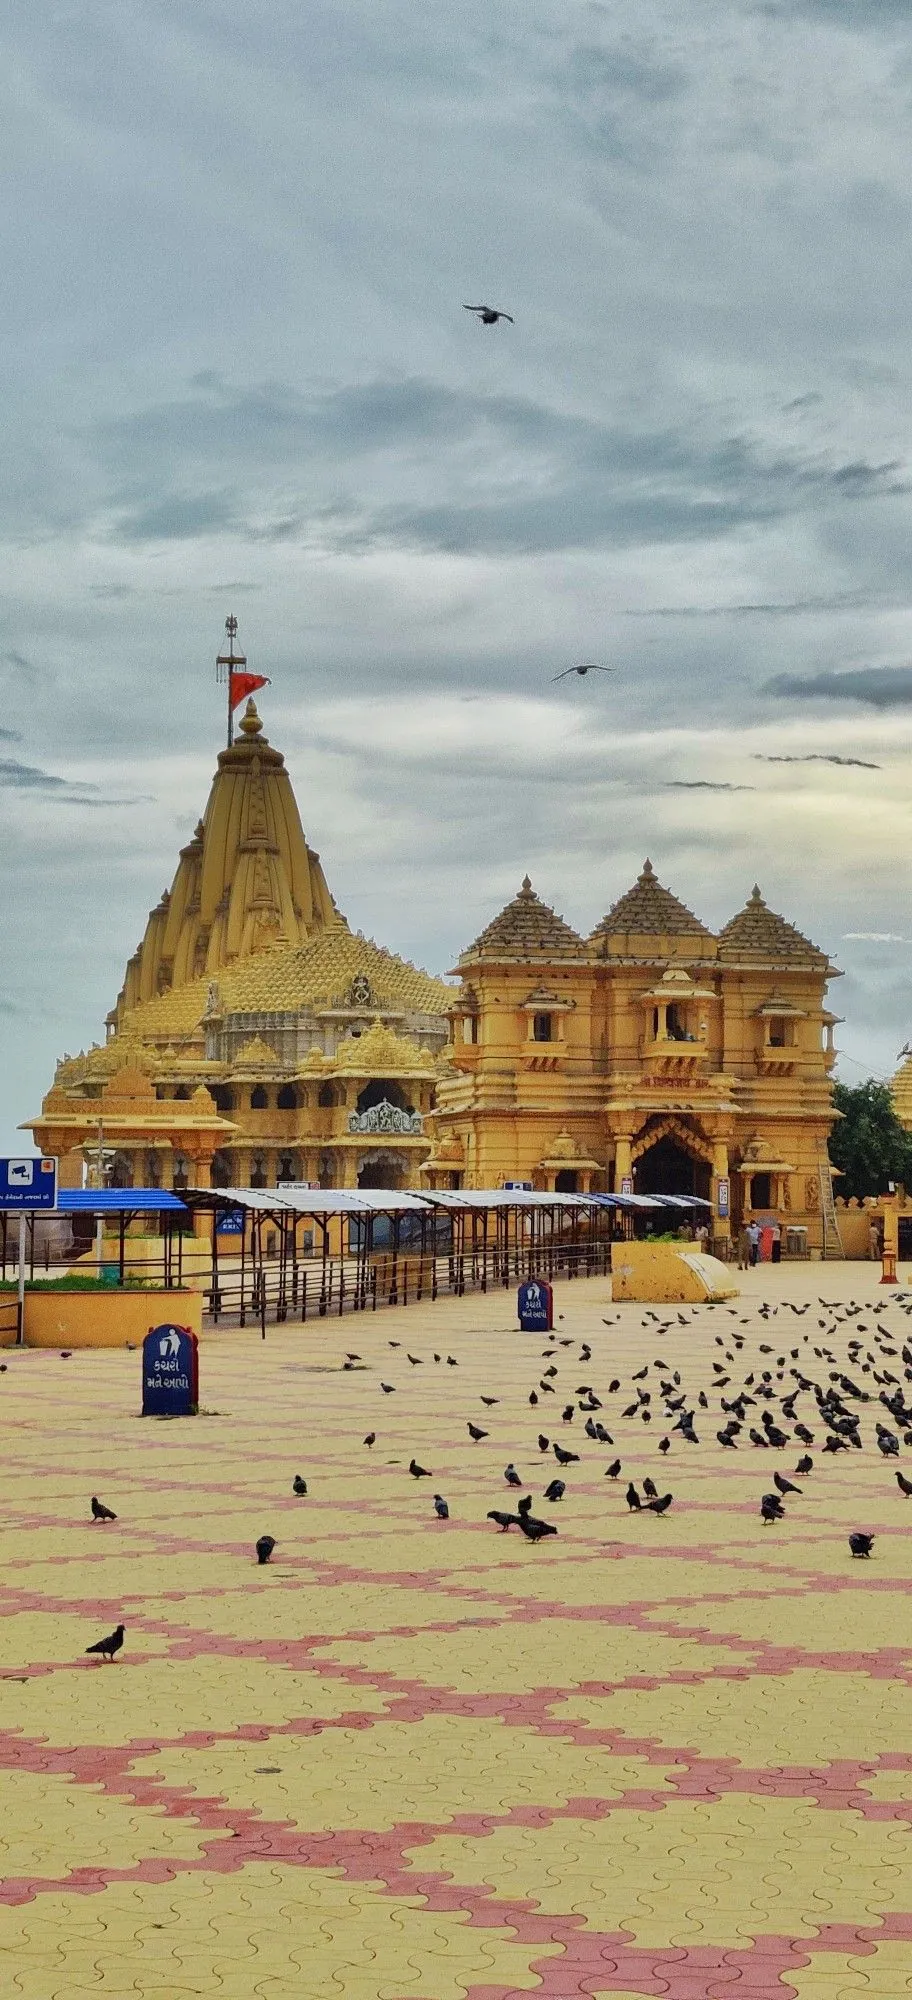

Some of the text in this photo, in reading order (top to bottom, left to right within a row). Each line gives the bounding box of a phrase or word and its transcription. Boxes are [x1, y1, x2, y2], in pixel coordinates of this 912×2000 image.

[153, 1358, 180, 1372] કચરો
[147, 1374, 189, 1389] મને આપો
